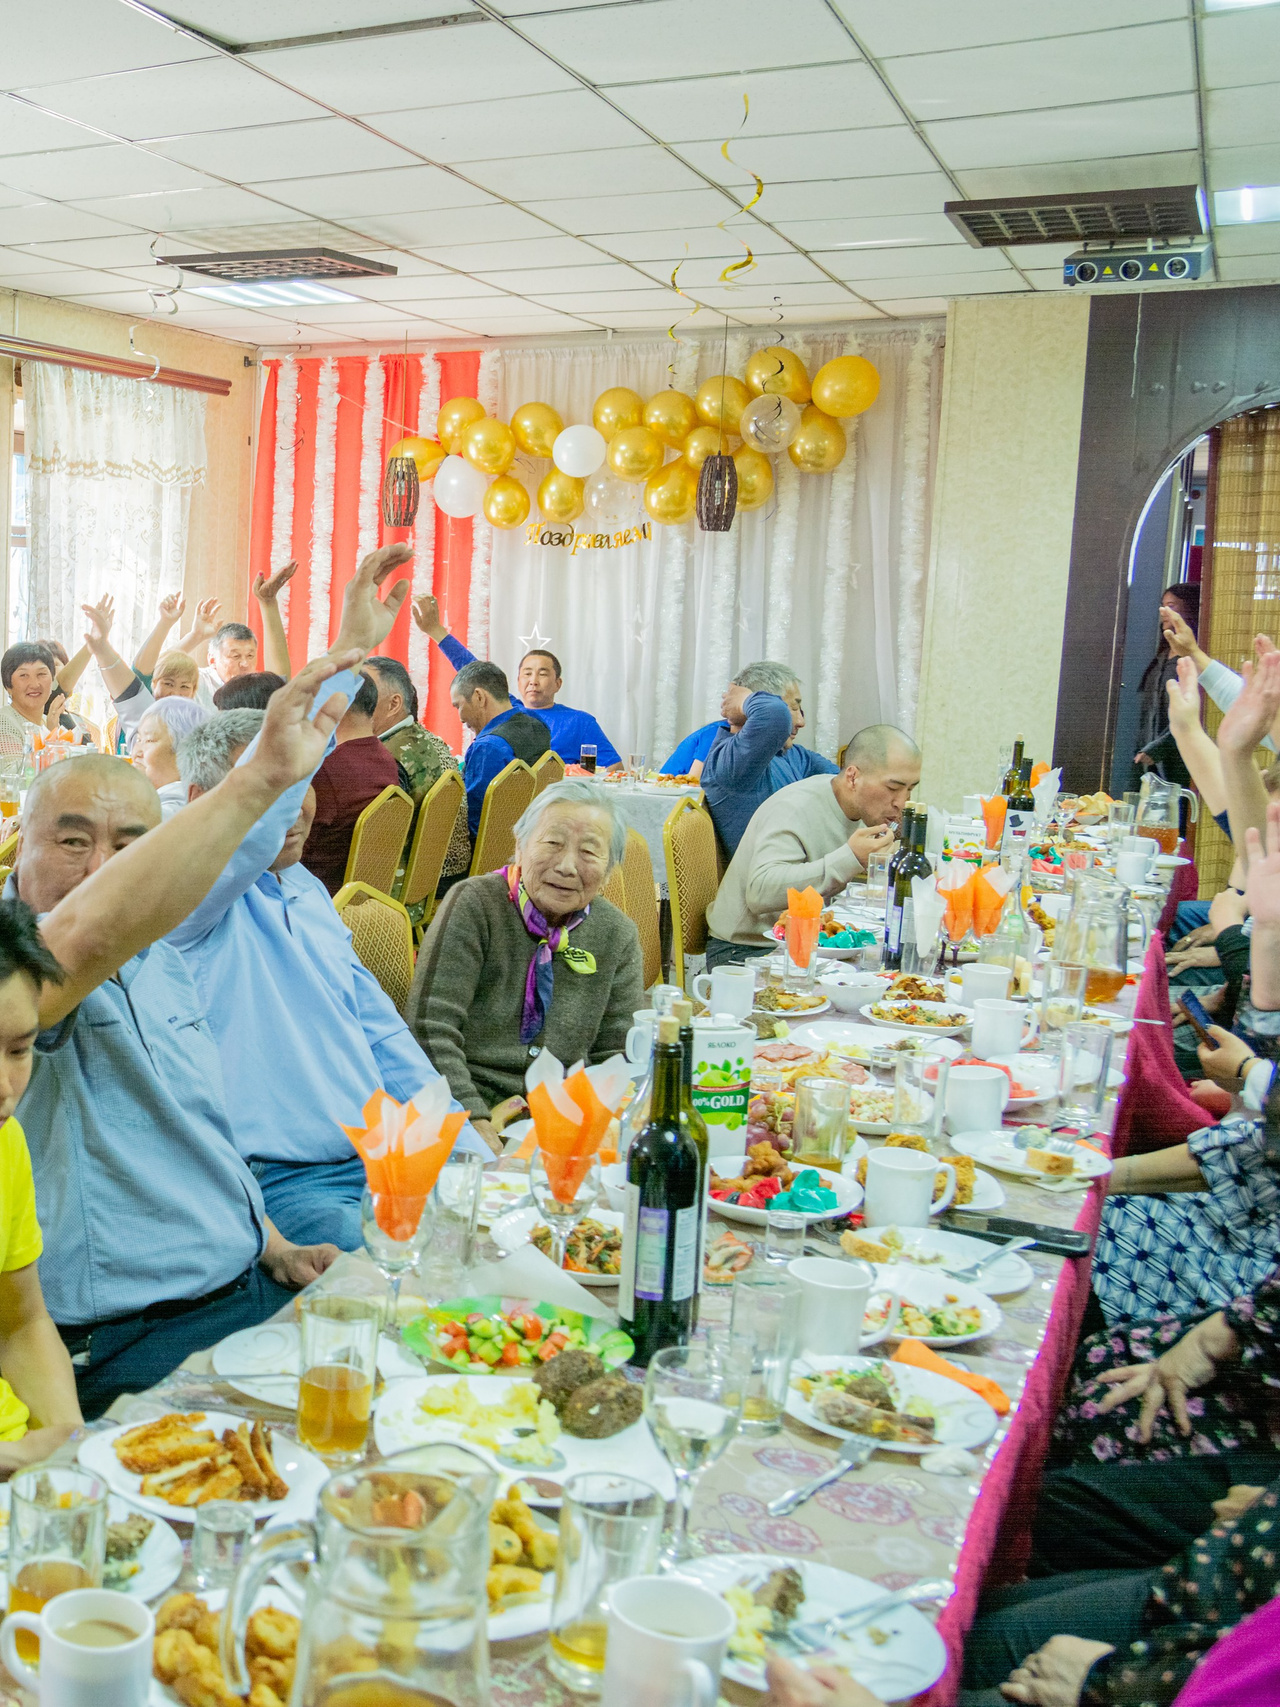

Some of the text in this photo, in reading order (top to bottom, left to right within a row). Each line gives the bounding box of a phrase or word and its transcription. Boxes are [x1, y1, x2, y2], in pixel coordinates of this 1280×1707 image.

[707, 1041, 737, 1049] ЯБЛОКО
[692, 1094, 746, 1110] 00% GOLD
